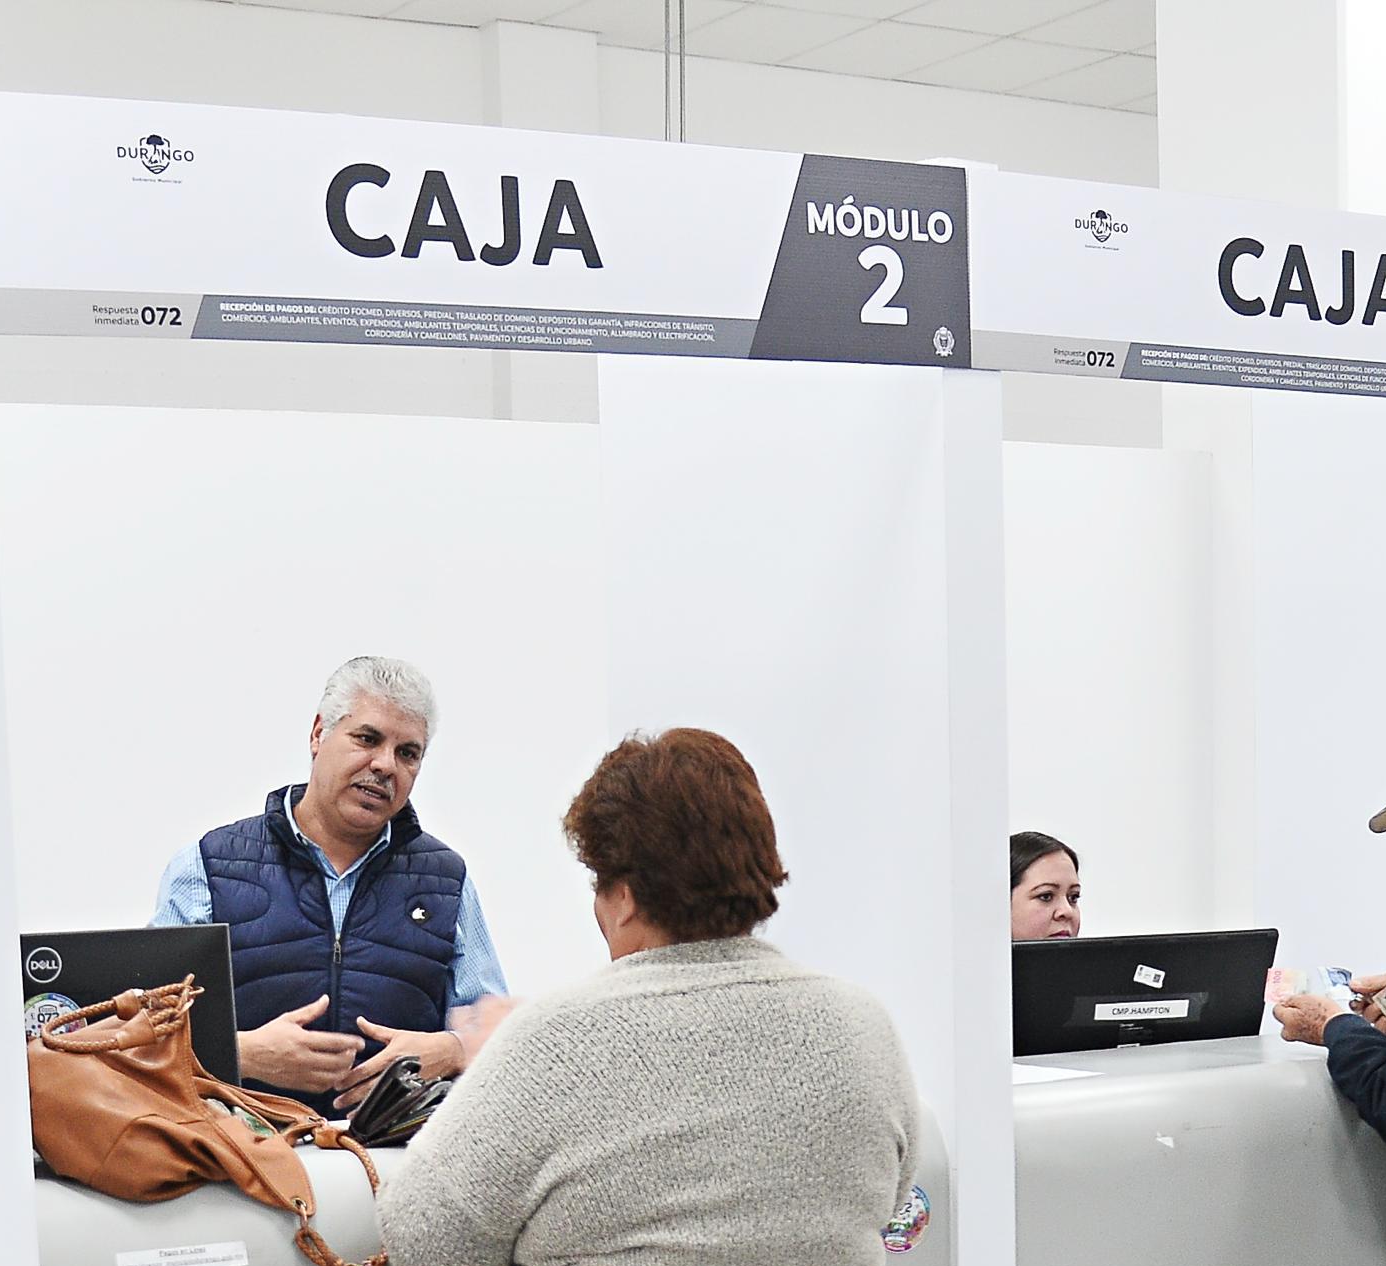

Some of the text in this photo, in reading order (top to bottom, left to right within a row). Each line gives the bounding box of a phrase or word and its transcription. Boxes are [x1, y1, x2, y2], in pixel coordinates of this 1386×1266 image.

[325, 162, 604, 268] CAJA
[806, 195, 953, 244] MÓDULO
[857, 244, 908, 325] 2
[93, 305, 182, 326] Respuesta 072
[95, 316, 140, 326] inmediata
[1086, 350, 1115, 367] 072
[30, 960, 59, 970] DELL
